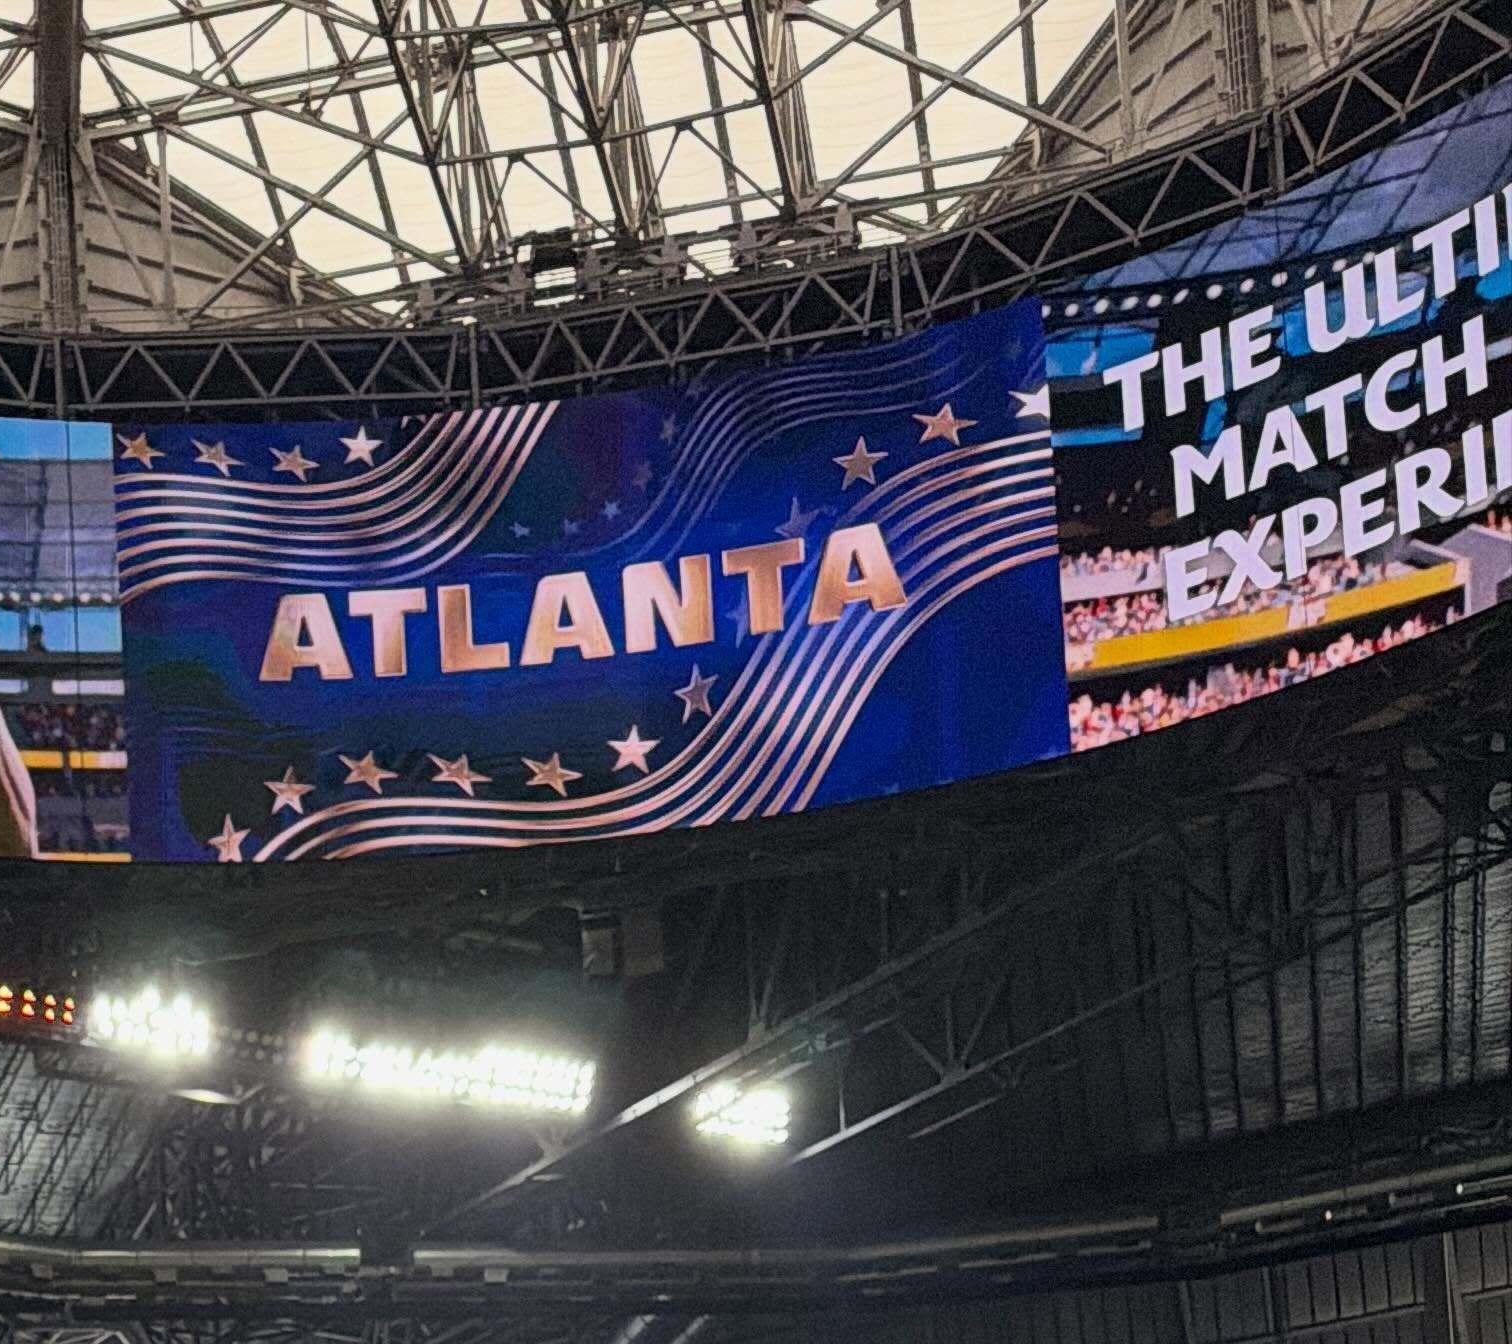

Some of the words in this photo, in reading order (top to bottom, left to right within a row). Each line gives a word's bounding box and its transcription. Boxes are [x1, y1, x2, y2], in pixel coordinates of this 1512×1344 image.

[1102, 304, 1281, 432] THE
[1170, 314, 1489, 518] MATCH
[258, 521, 909, 683] ATLANTA
